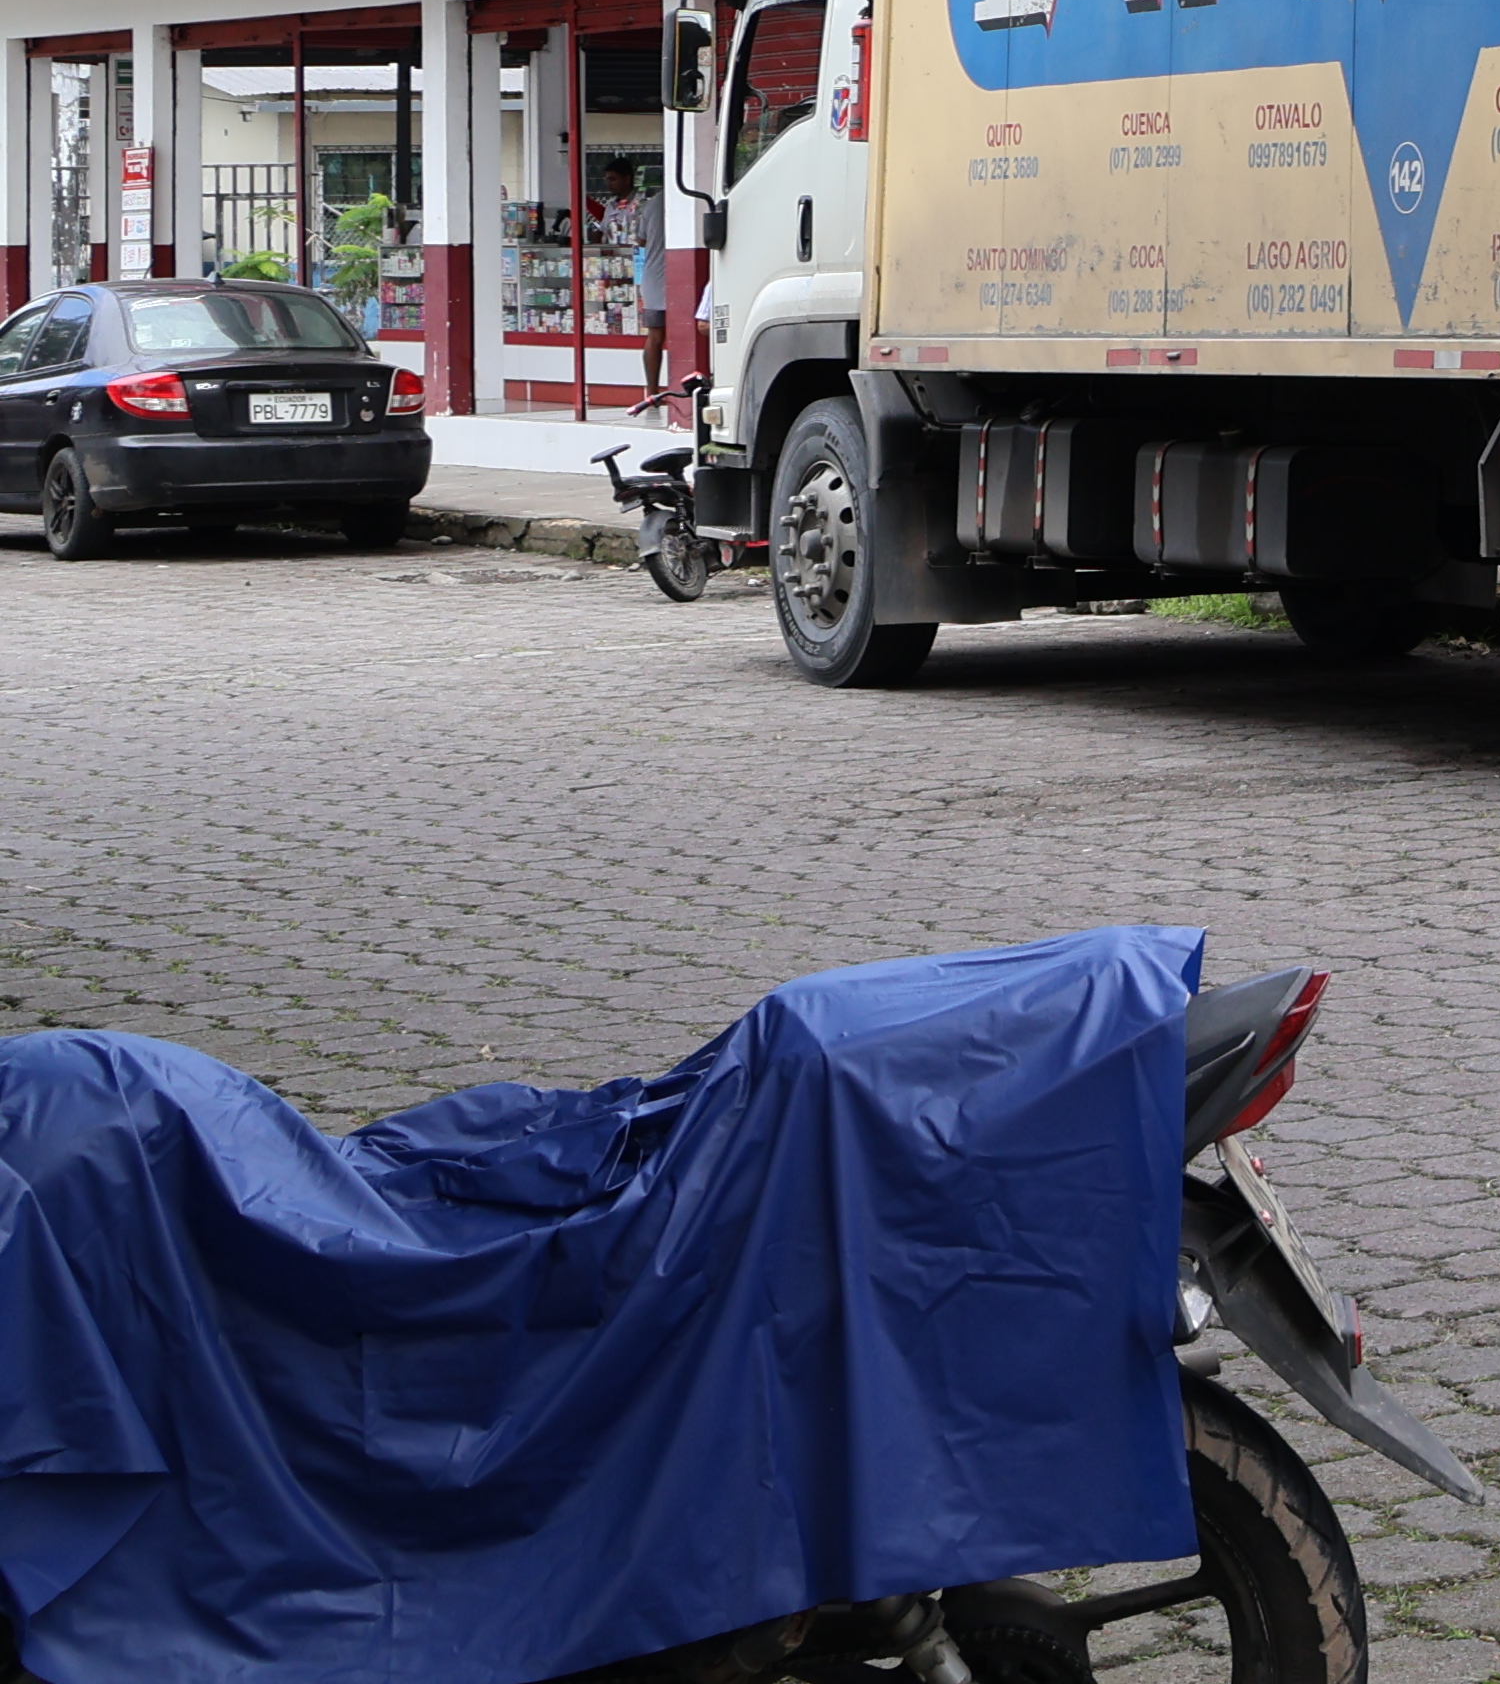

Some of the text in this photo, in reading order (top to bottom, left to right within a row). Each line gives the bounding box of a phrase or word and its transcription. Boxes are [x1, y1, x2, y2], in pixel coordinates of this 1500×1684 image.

[1122, 112, 1171, 136] CUENCA
[1255, 102, 1322, 130] OTAVALO
[986, 123, 1022, 147] QUITO
[1109, 144, 1182, 175] (07) 280 2999
[1248, 141, 1327, 168] 0997891679
[968, 158, 988, 186] (02)
[990, 157, 1010, 180] 252
[1391, 160, 1422, 193] 142
[967, 247, 1067, 272] SANTO DOMINGO
[1129, 245, 1165, 269] COCA
[1246, 240, 1347, 270] LAGO AGRIO
[979, 283, 1000, 311] (02)
[1002, 283, 1022, 306] 274
[1108, 290, 1129, 319] (06)
[1247, 284, 1344, 320] (06) 282 0491
[253, 403, 328, 421] PBL-7779
